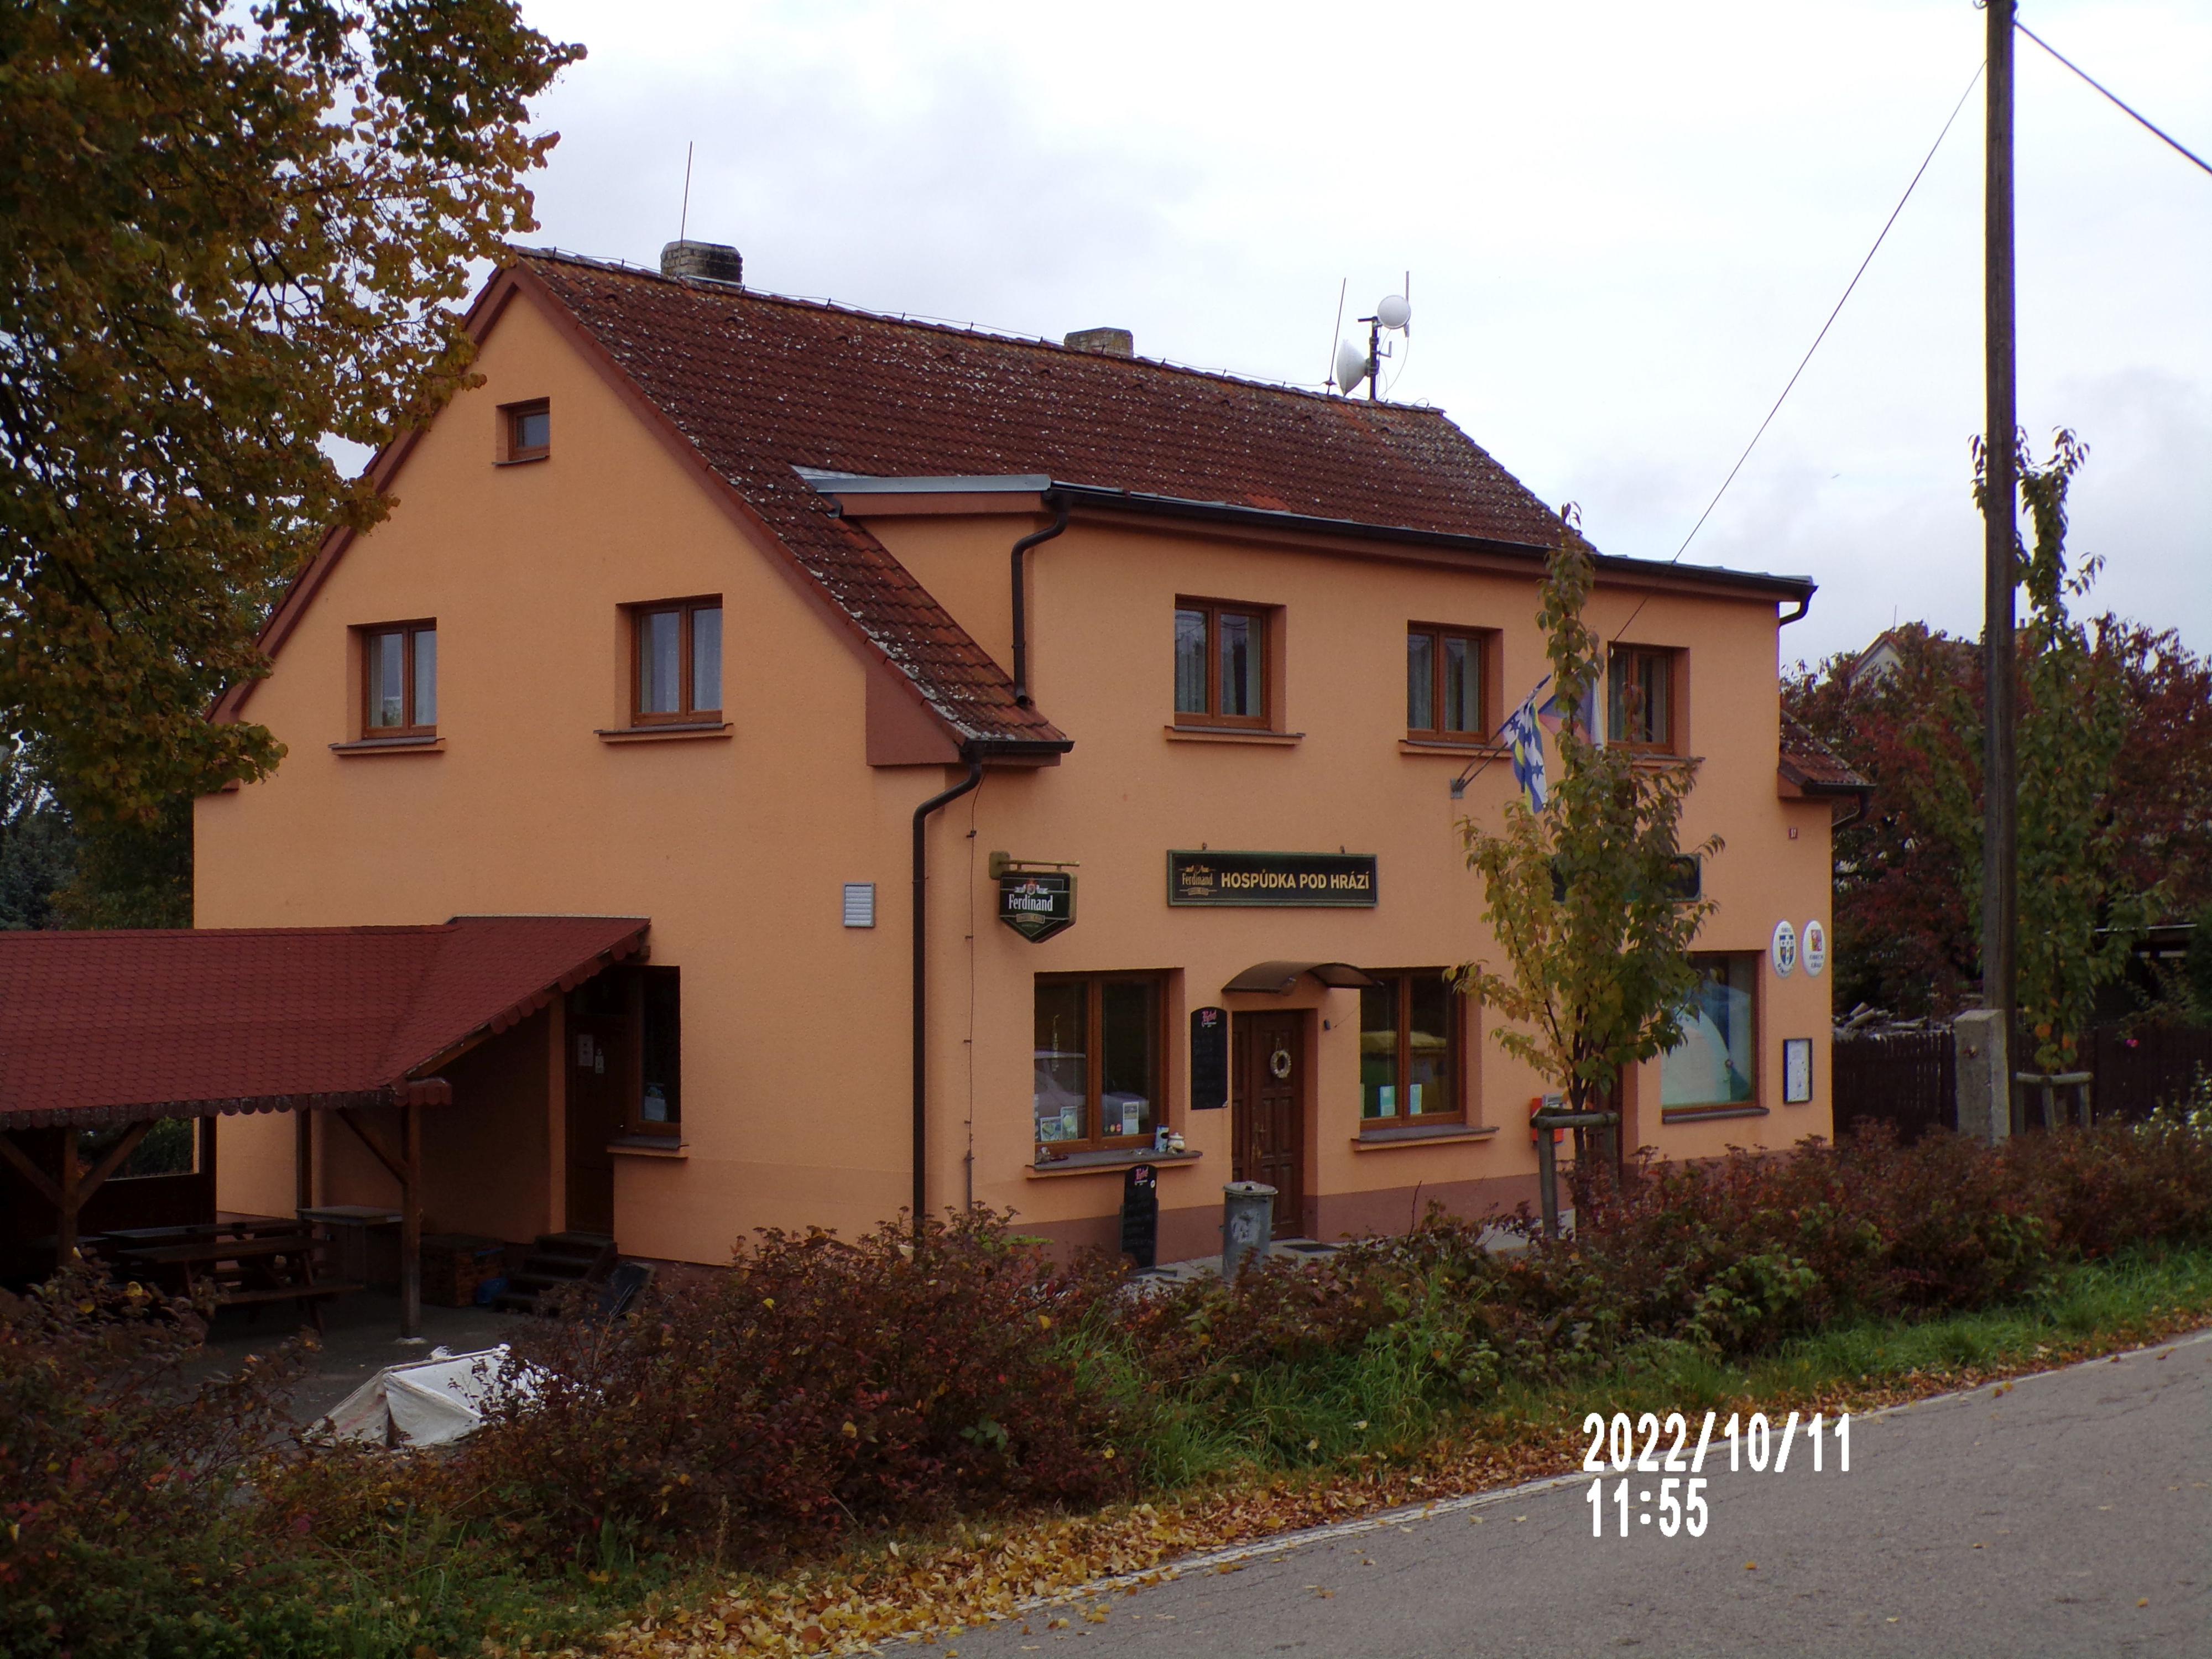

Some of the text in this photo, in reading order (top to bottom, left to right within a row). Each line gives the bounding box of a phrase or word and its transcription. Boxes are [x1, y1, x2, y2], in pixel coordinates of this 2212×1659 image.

[1182, 872, 1213, 885] Ferdinand
[1300, 873, 1327, 889] POD
[1330, 870, 1369, 889] HRÁZÍ
[1009, 894, 1053, 911] Ferdinand
